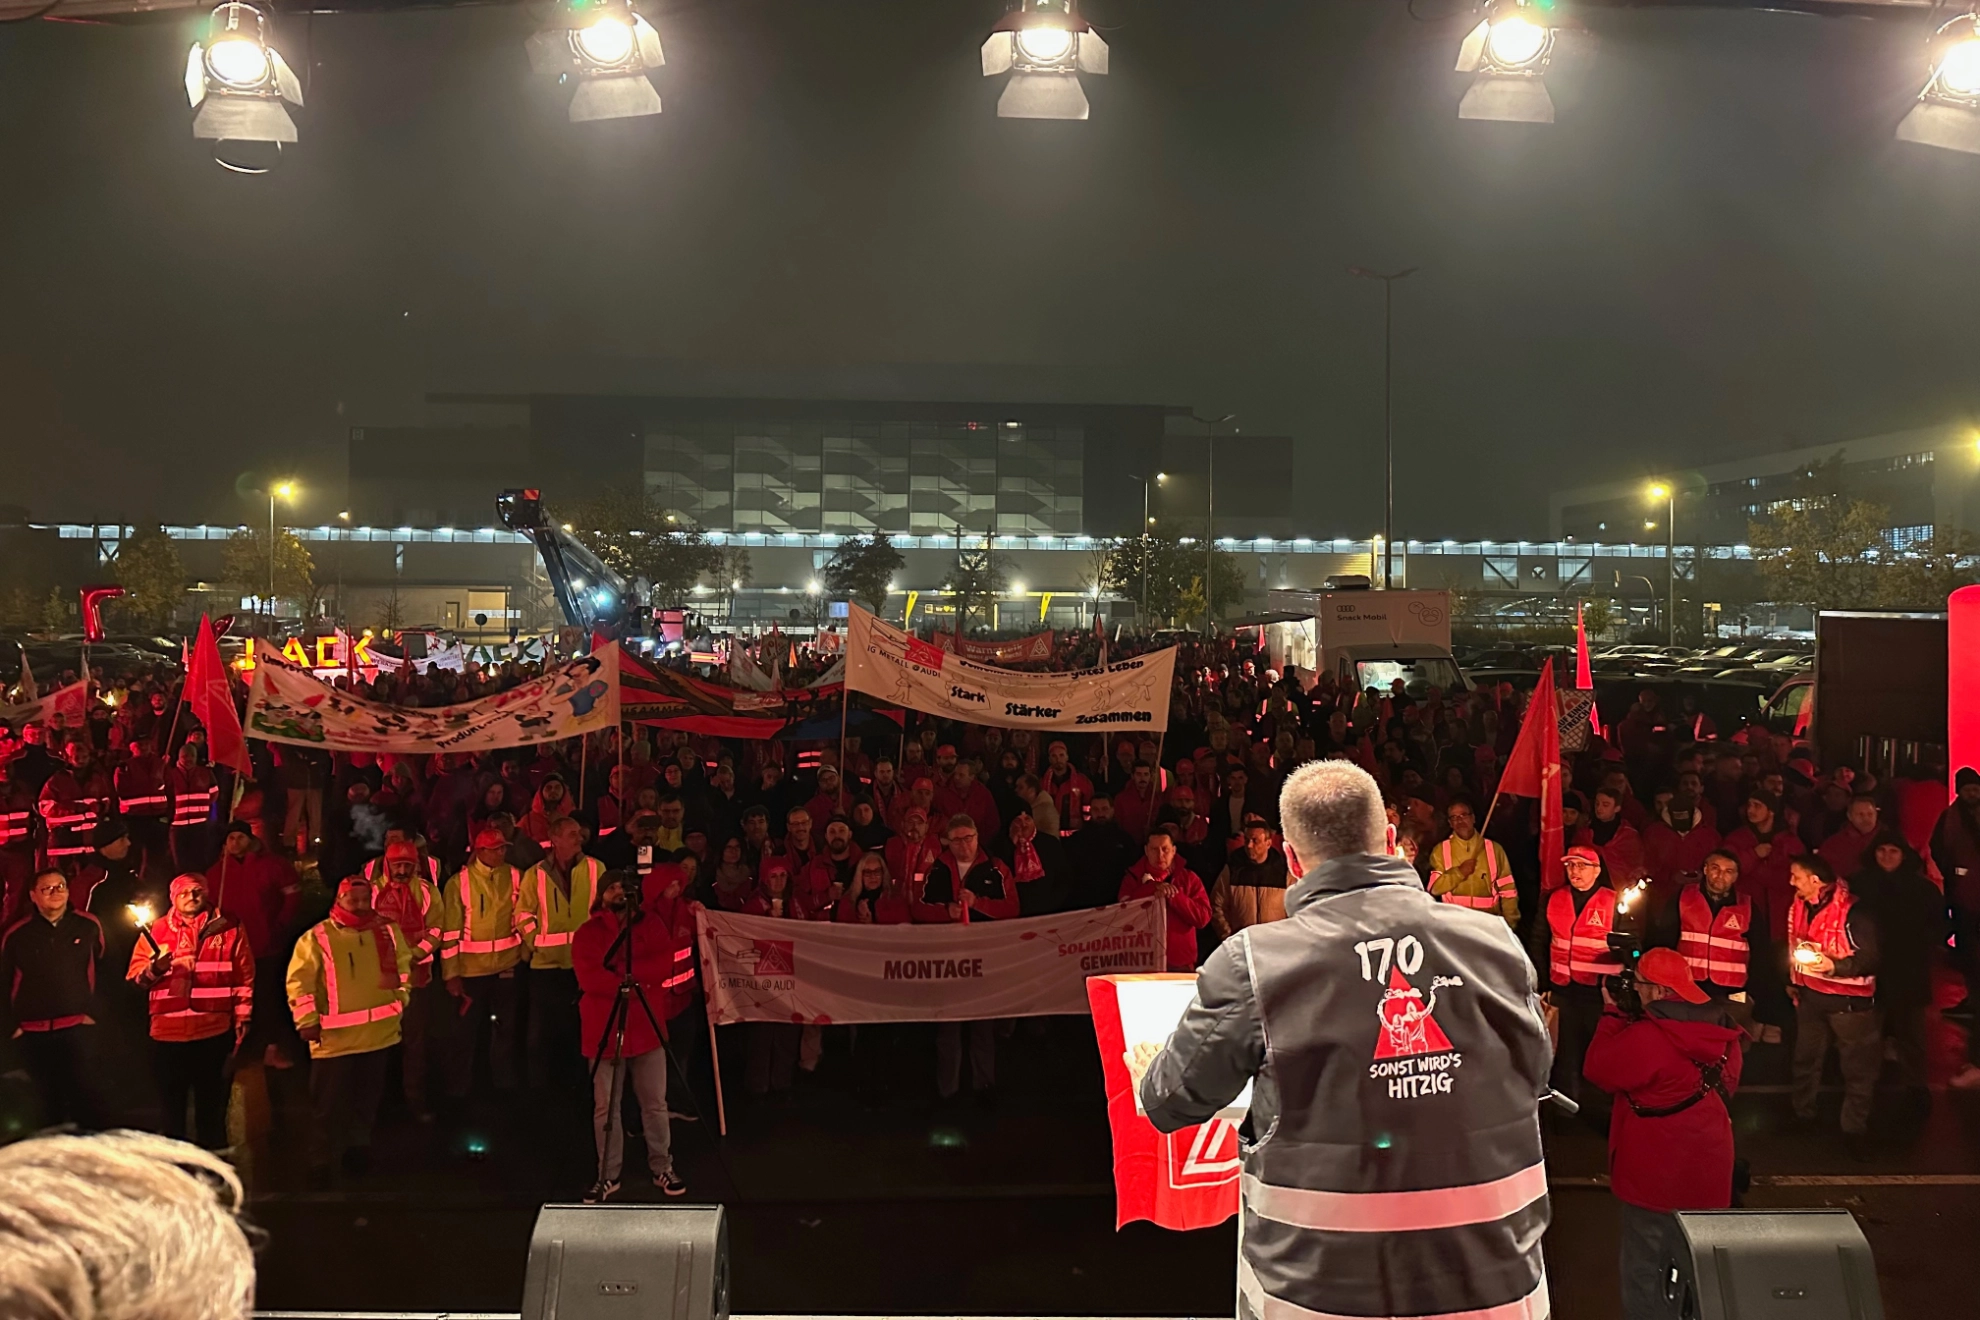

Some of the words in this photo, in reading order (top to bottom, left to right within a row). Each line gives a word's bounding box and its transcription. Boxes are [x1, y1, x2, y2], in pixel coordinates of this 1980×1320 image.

[1363, 613, 1387, 621] Mobil
[867, 644, 876, 653] IG
[950, 685, 986, 703] Stark
[1005, 702, 1062, 719] Stärker
[1567, 699, 1590, 719] EINEN
[1560, 708, 1590, 735] STREICH
[1058, 930, 1154, 957] SOLIDARITÄT
[883, 958, 983, 980] MONTAGE
[1080, 951, 1154, 971] GEWINNT!
[1354, 934, 1424, 986] 170
[718, 979, 727, 989] IG
[728, 977, 762, 991] METALL
[762, 978, 772, 991] @
[774, 980, 796, 991] AUDI
[1369, 1059, 1415, 1078] SONST
[1417, 1053, 1462, 1073] WIRD'S
[1388, 1073, 1455, 1098] HITZIG
